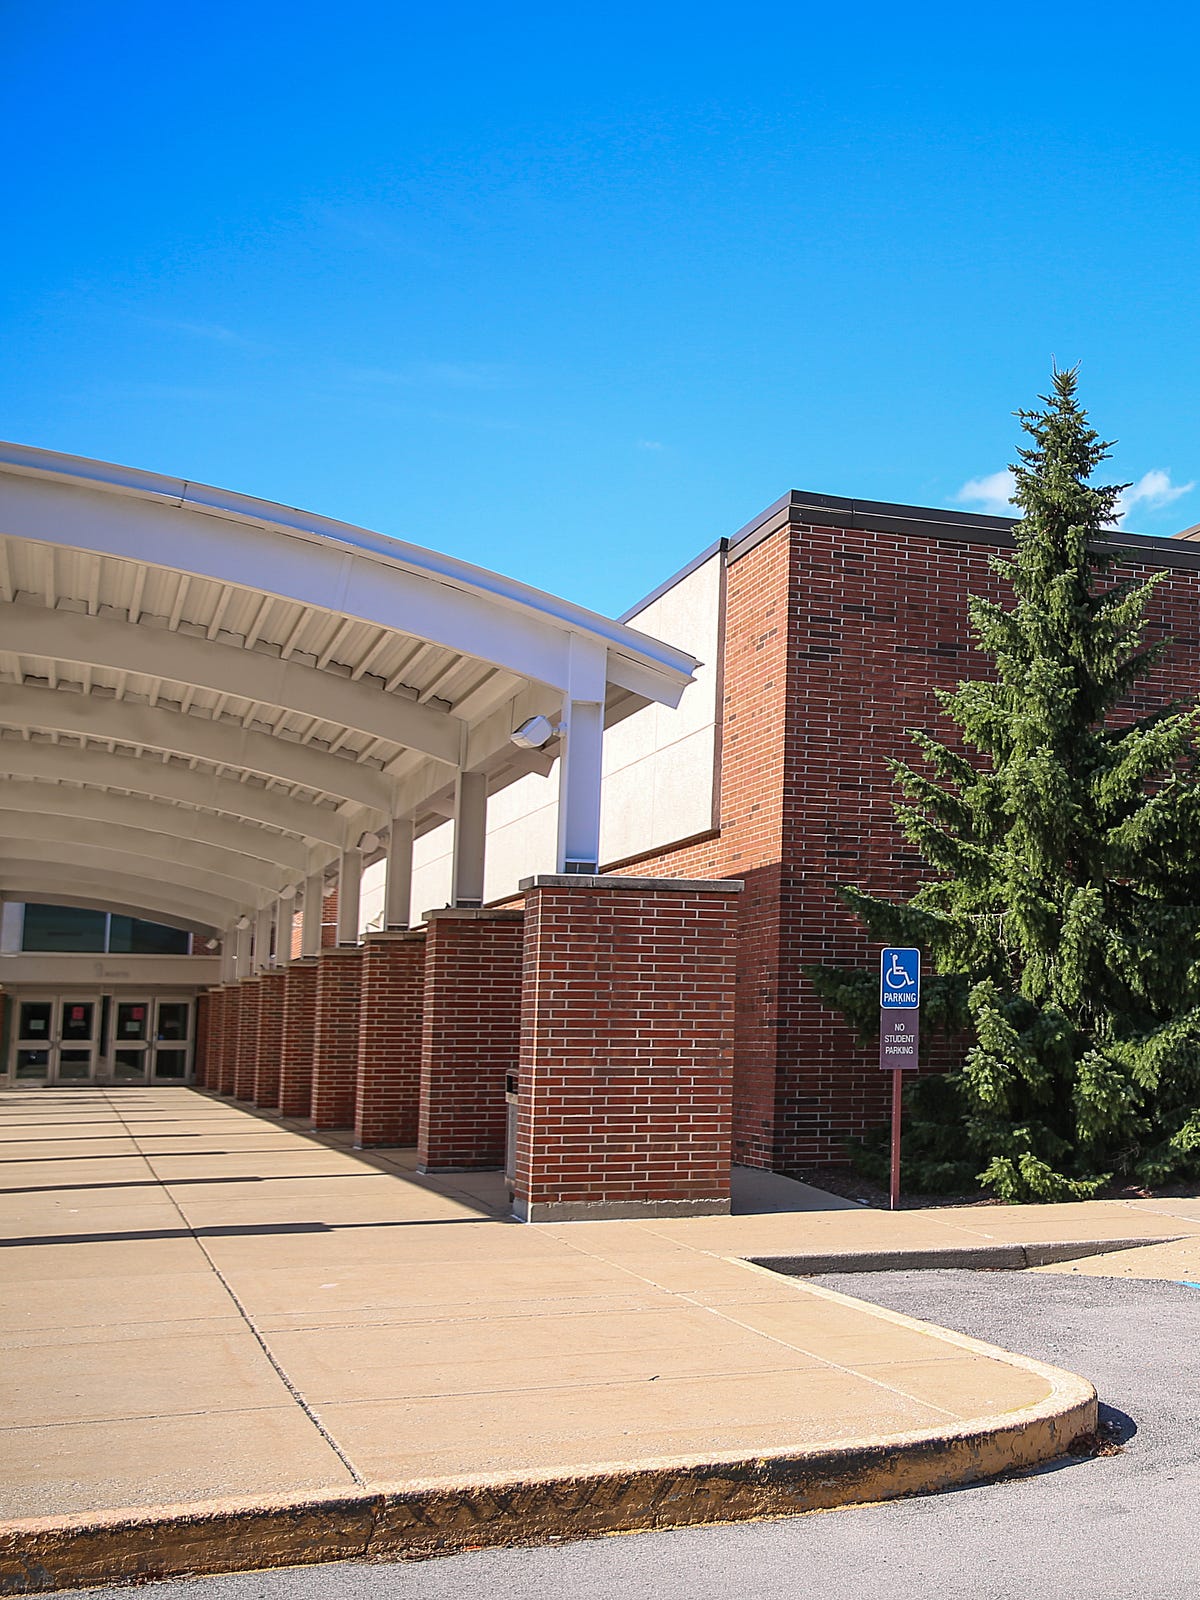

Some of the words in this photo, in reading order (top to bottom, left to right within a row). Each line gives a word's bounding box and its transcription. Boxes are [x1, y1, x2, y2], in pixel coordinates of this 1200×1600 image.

[883, 992, 916, 1003] PARKING
[894, 1023, 905, 1032] NO
[884, 1034, 915, 1043] STUDENT
[885, 1046, 914, 1055] PARKING
